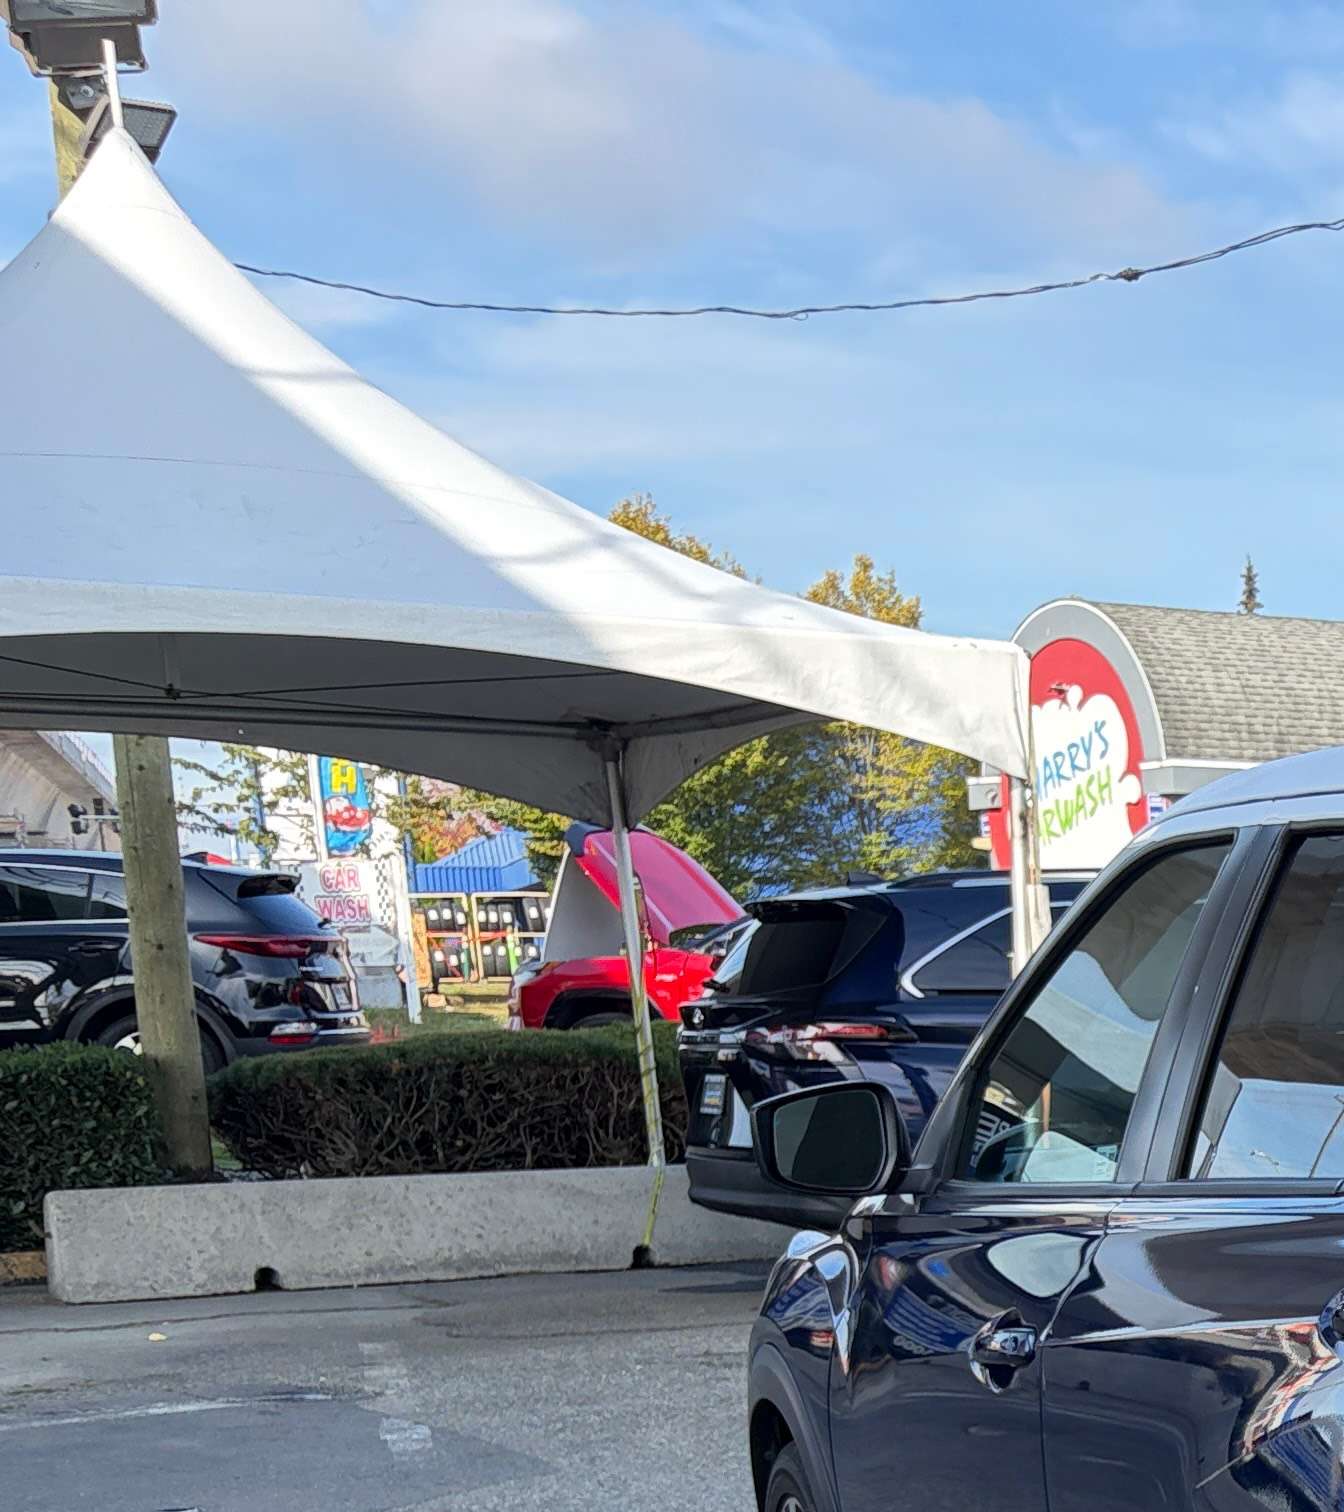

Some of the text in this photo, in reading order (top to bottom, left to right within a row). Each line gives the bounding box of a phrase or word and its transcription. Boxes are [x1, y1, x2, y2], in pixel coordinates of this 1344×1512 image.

[1037, 764, 1113, 846] RWASH
[321, 865, 361, 892] CAR
[314, 895, 372, 922] WASH
